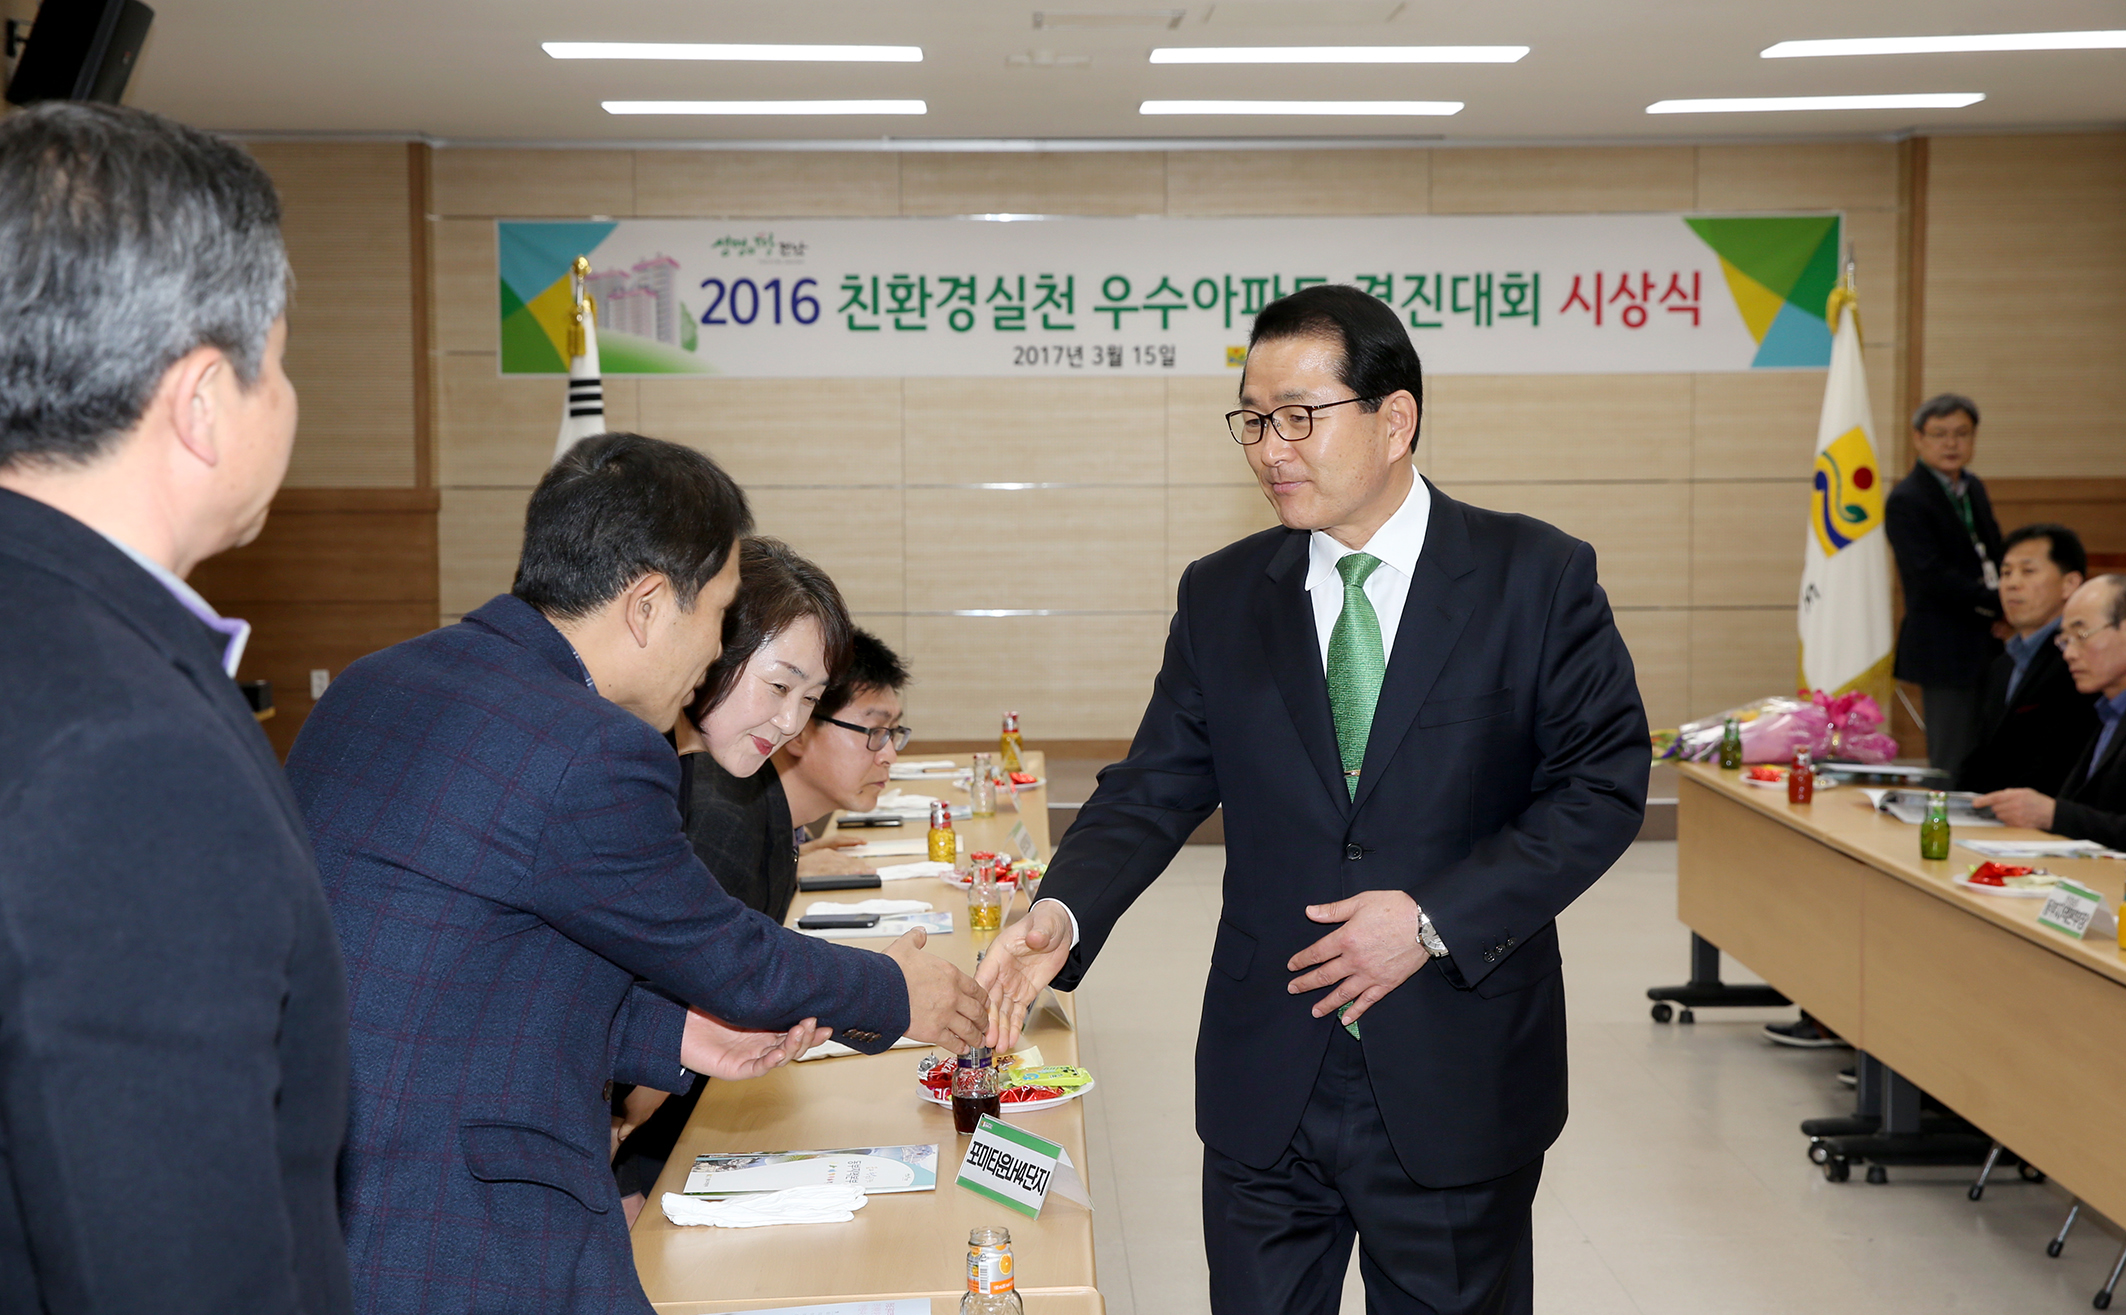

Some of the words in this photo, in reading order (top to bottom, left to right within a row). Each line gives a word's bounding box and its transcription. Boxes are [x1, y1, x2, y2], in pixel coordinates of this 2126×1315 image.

[700, 277, 821, 326] 2016
[838, 274, 1075, 333] 친환경실천
[1356, 272, 1540, 329] 경진대회
[1560, 271, 1701, 329] 시상식
[1013, 345, 1084, 368] 2017년
[1092, 344, 1123, 368] 3월
[1133, 344, 1176, 368] 15일
